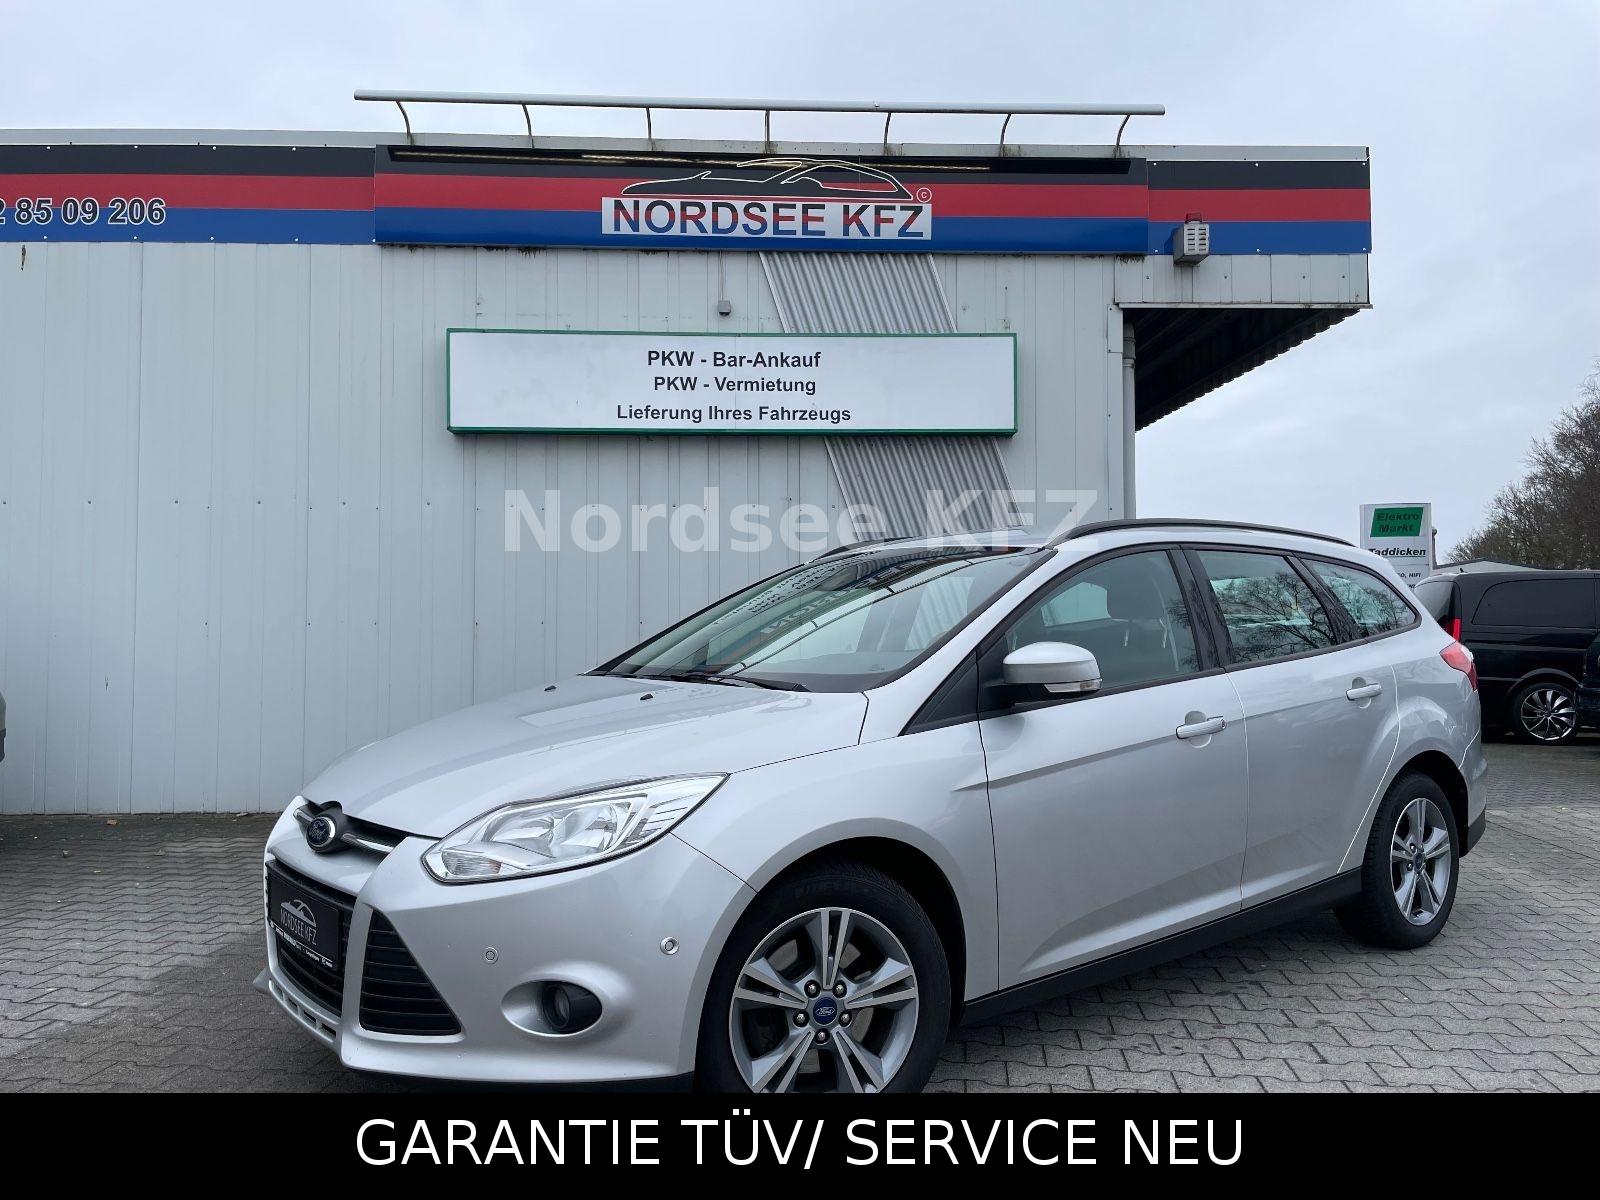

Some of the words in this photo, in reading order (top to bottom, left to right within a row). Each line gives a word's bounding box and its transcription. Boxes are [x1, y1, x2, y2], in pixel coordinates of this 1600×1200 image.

[15, 197, 53, 225] 85
[61, 197, 100, 225] 09
[107, 197, 166, 225] 206
[613, 199, 826, 237] NORDSEE
[842, 204, 924, 238] KFZ
[647, 350, 695, 367] PKW
[713, 351, 822, 368] Bar-Ankauf
[654, 376, 698, 391] PKW
[714, 376, 816, 396] Vermietung
[617, 404, 702, 424] Lieferung
[708, 405, 753, 421] Ihres
[758, 406, 851, 425] Fahrzeugs
[1377, 512, 1419, 520] Elektro
[1379, 524, 1413, 532] Markt
[1368, 547, 1426, 556] Taddicken
